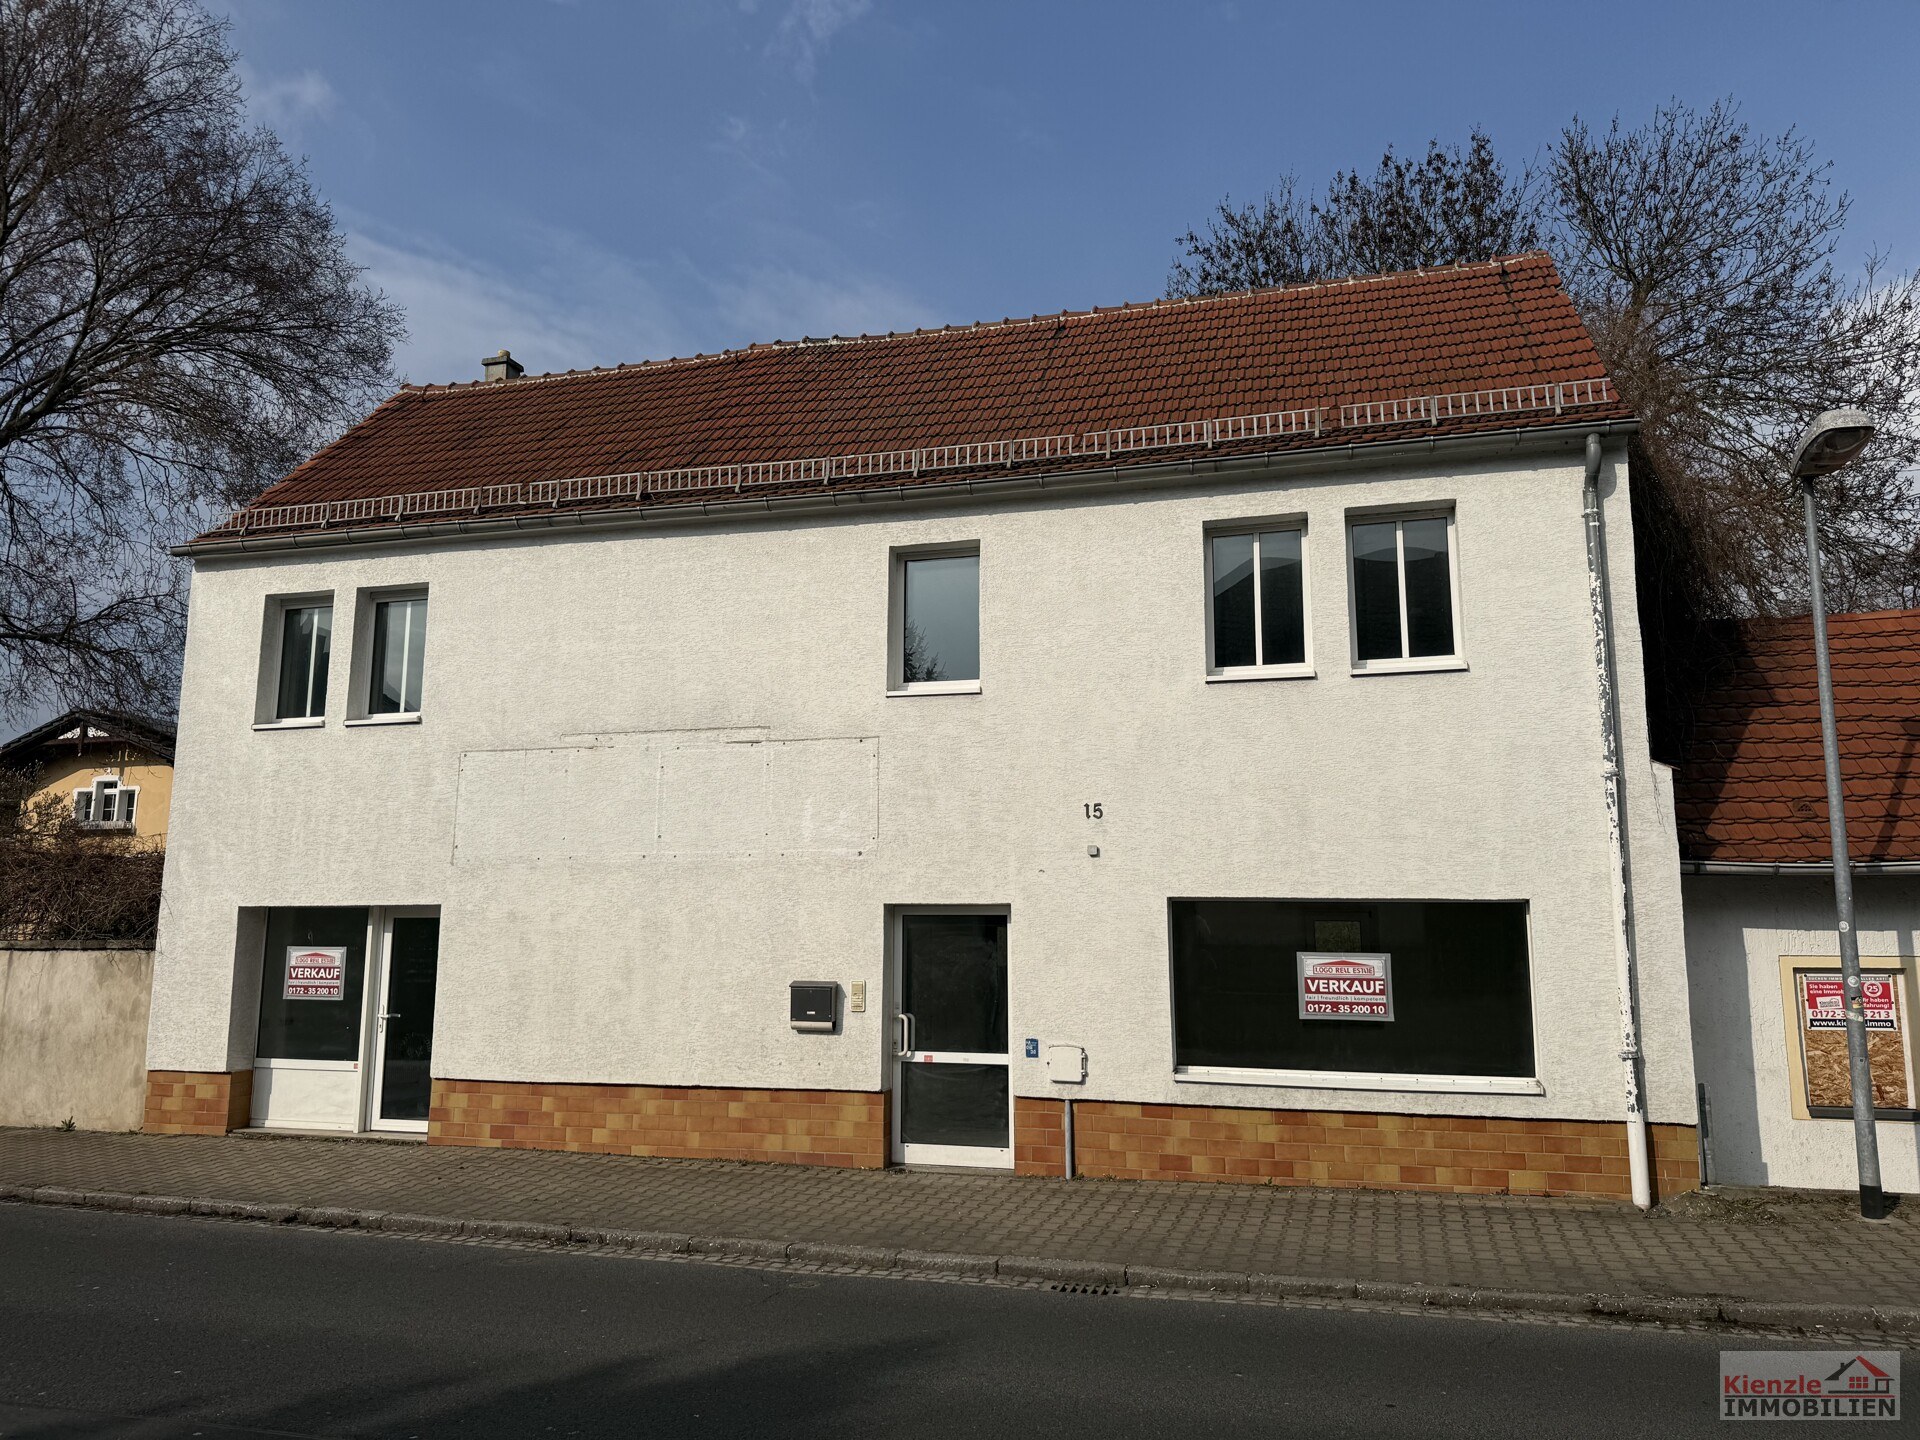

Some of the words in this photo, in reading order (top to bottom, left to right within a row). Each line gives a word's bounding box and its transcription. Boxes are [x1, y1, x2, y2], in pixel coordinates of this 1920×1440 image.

[1084, 802, 1104, 820] 15
[290, 968, 340, 978] VERKAUF
[1307, 980, 1384, 993] VERKAUF
[1308, 1004, 1331, 1012] 0172
[1338, 1004, 1350, 1013] 35
[1352, 1005, 1370, 1014] 200
[1372, 1006, 1385, 1014] 10
